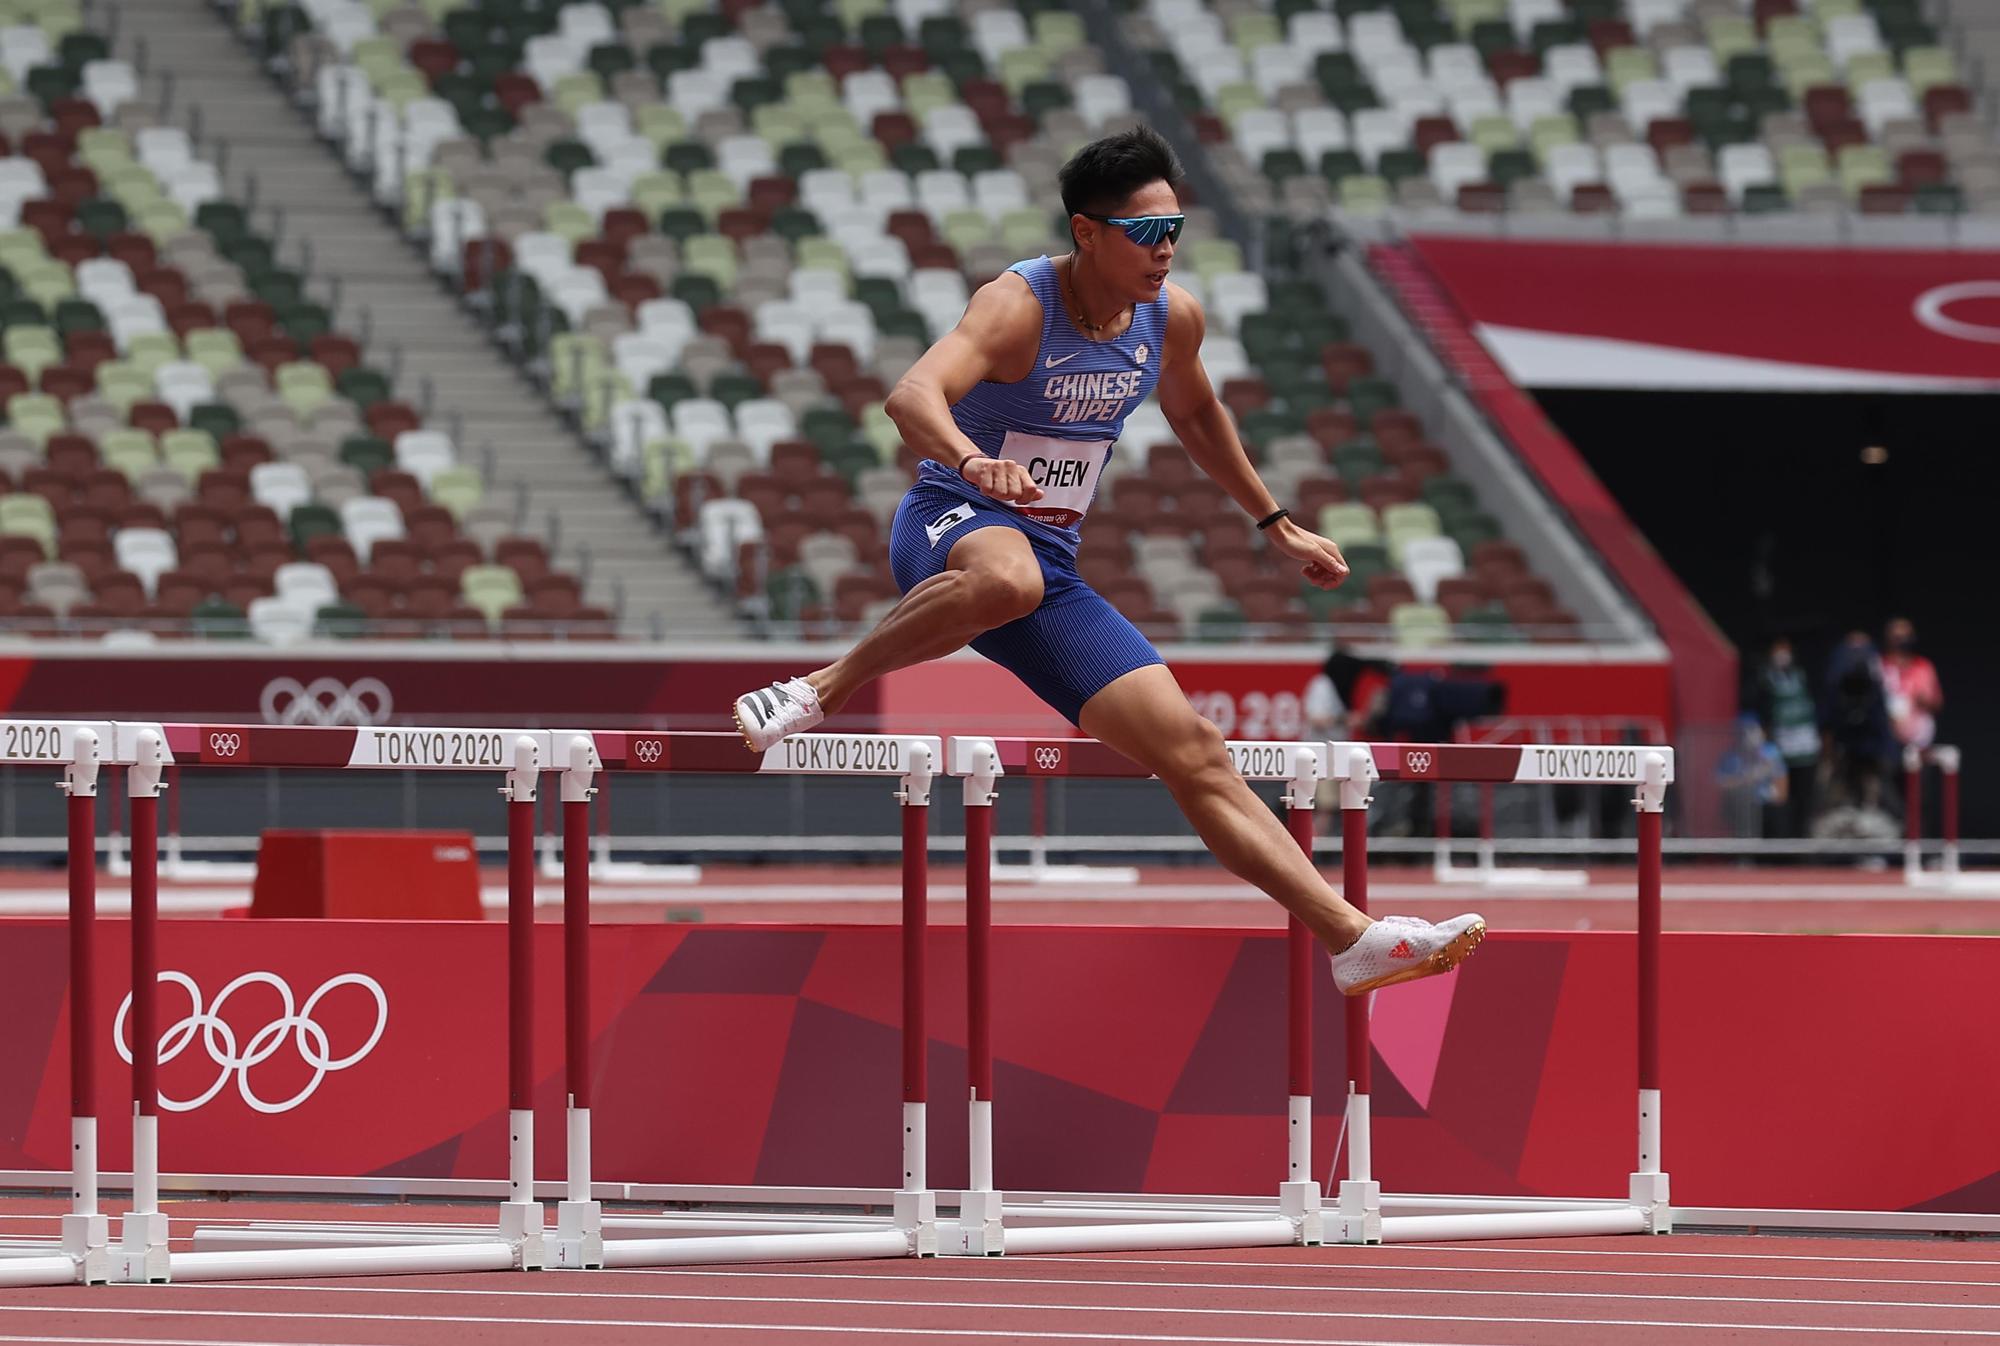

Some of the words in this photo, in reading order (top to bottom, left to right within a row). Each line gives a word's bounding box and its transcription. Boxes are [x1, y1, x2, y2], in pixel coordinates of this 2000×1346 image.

[1044, 371, 1142, 400] CHINESE
[1052, 400, 1125, 423] TAIPEI
[1029, 457, 1090, 487] CHEN
[6, 725, 61, 758] 2020
[374, 732, 445, 764] TOKYO
[451, 734, 503, 765] 2020
[783, 738, 847, 769] TOKYO
[852, 740, 899, 770] 2020
[1241, 748, 1285, 776] 2020
[1536, 749, 1592, 777] TOKYO
[1596, 750, 1637, 778] 2020
